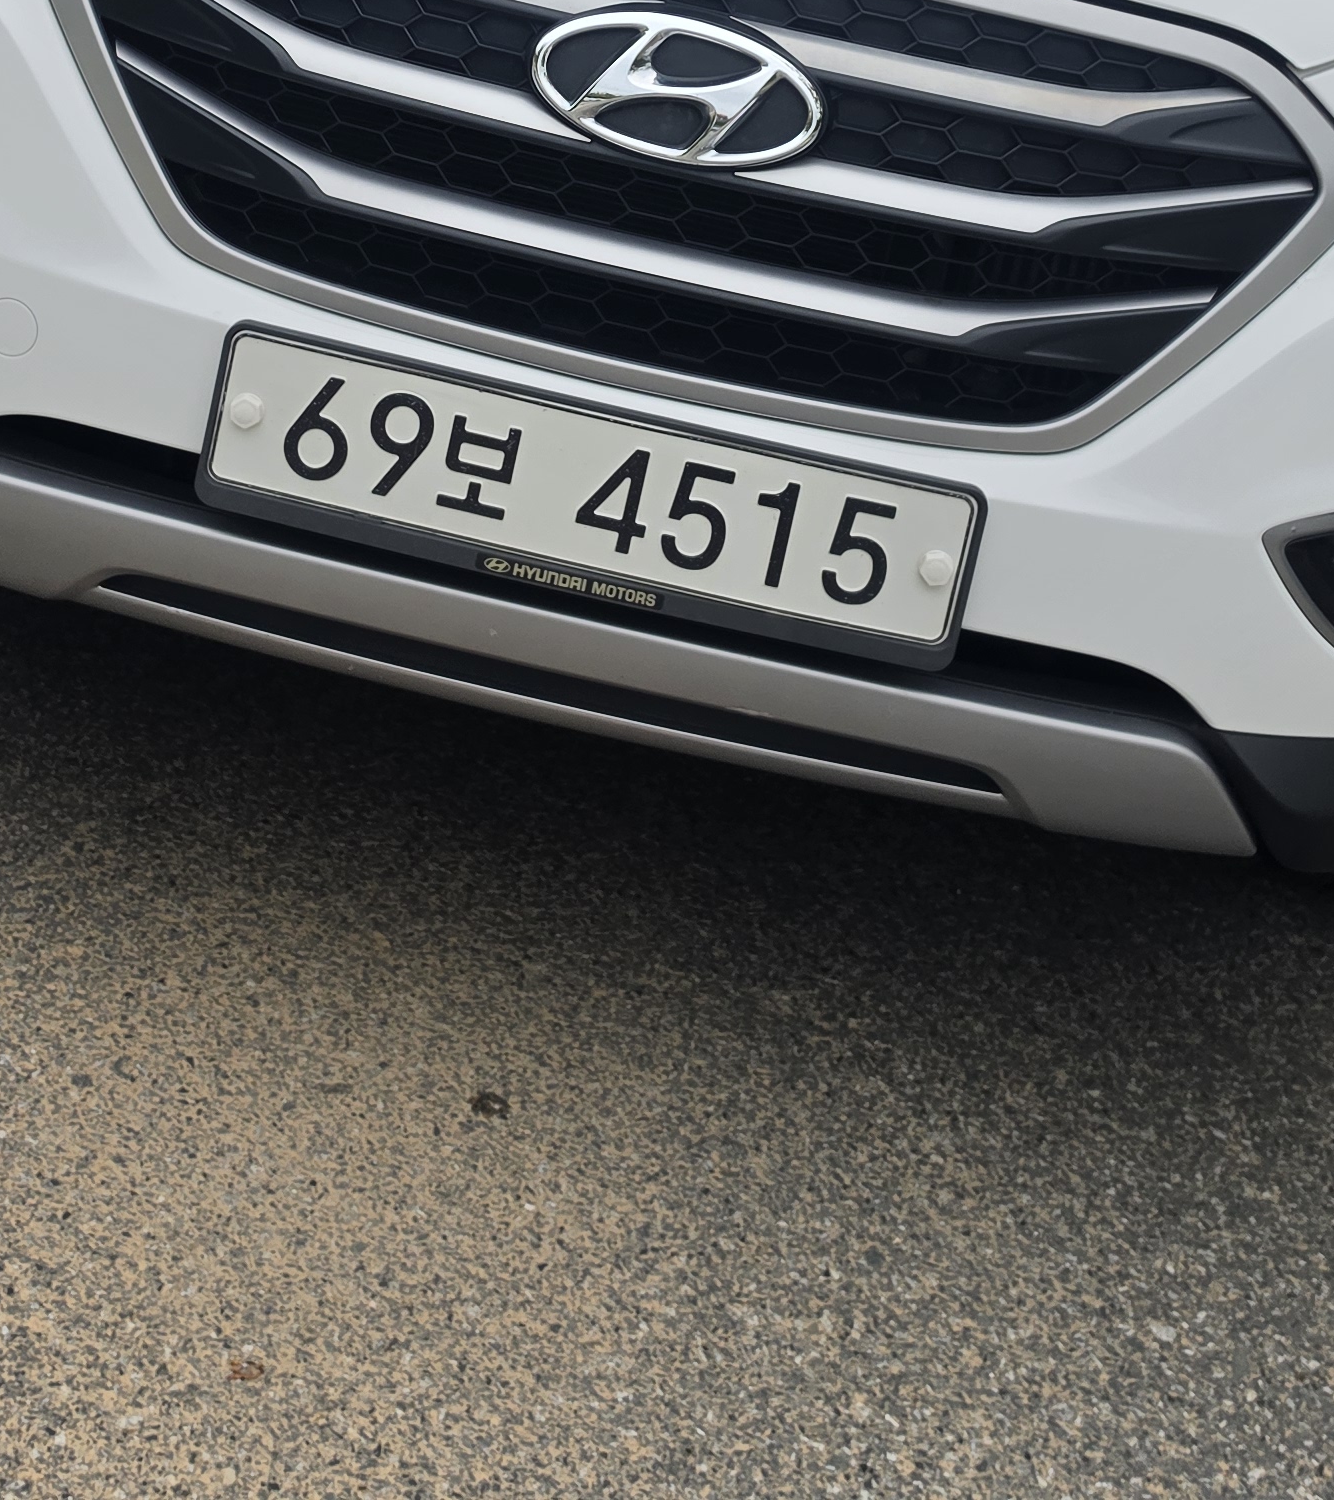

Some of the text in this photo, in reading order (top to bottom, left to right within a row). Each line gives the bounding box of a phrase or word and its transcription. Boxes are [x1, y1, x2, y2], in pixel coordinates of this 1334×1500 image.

[283, 377, 897, 605] 69보 4515
[512, 562, 657, 607] HYUNDAI MOTORS
